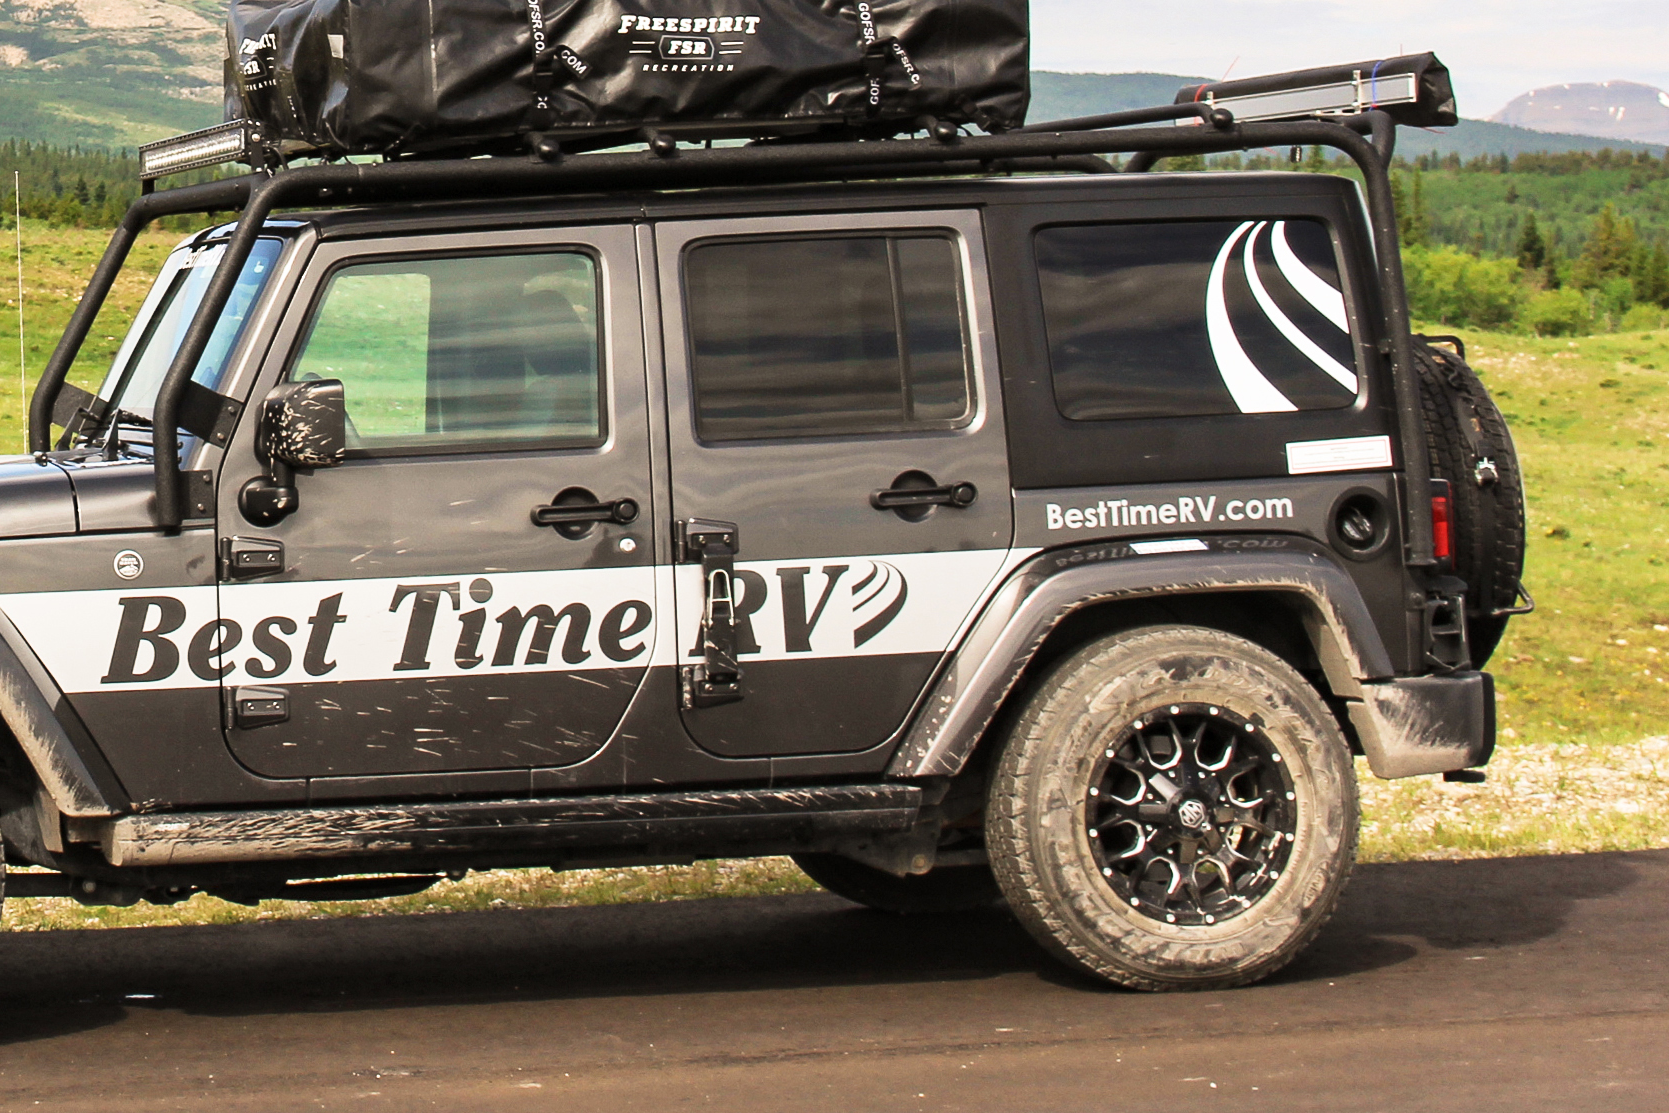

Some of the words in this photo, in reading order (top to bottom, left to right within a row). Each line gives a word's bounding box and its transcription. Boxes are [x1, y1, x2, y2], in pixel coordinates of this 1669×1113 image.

[617, 14, 761, 35] FREESPIRIT
[667, 40, 707, 55] FSR
[642, 64, 735, 72] RECREATION
[869, 78, 880, 105] GOF
[1046, 495, 1294, 530] BestTimeRV.com
[100, 592, 348, 684] Best
[389, 578, 652, 671] Time
[689, 564, 849, 658] RV
